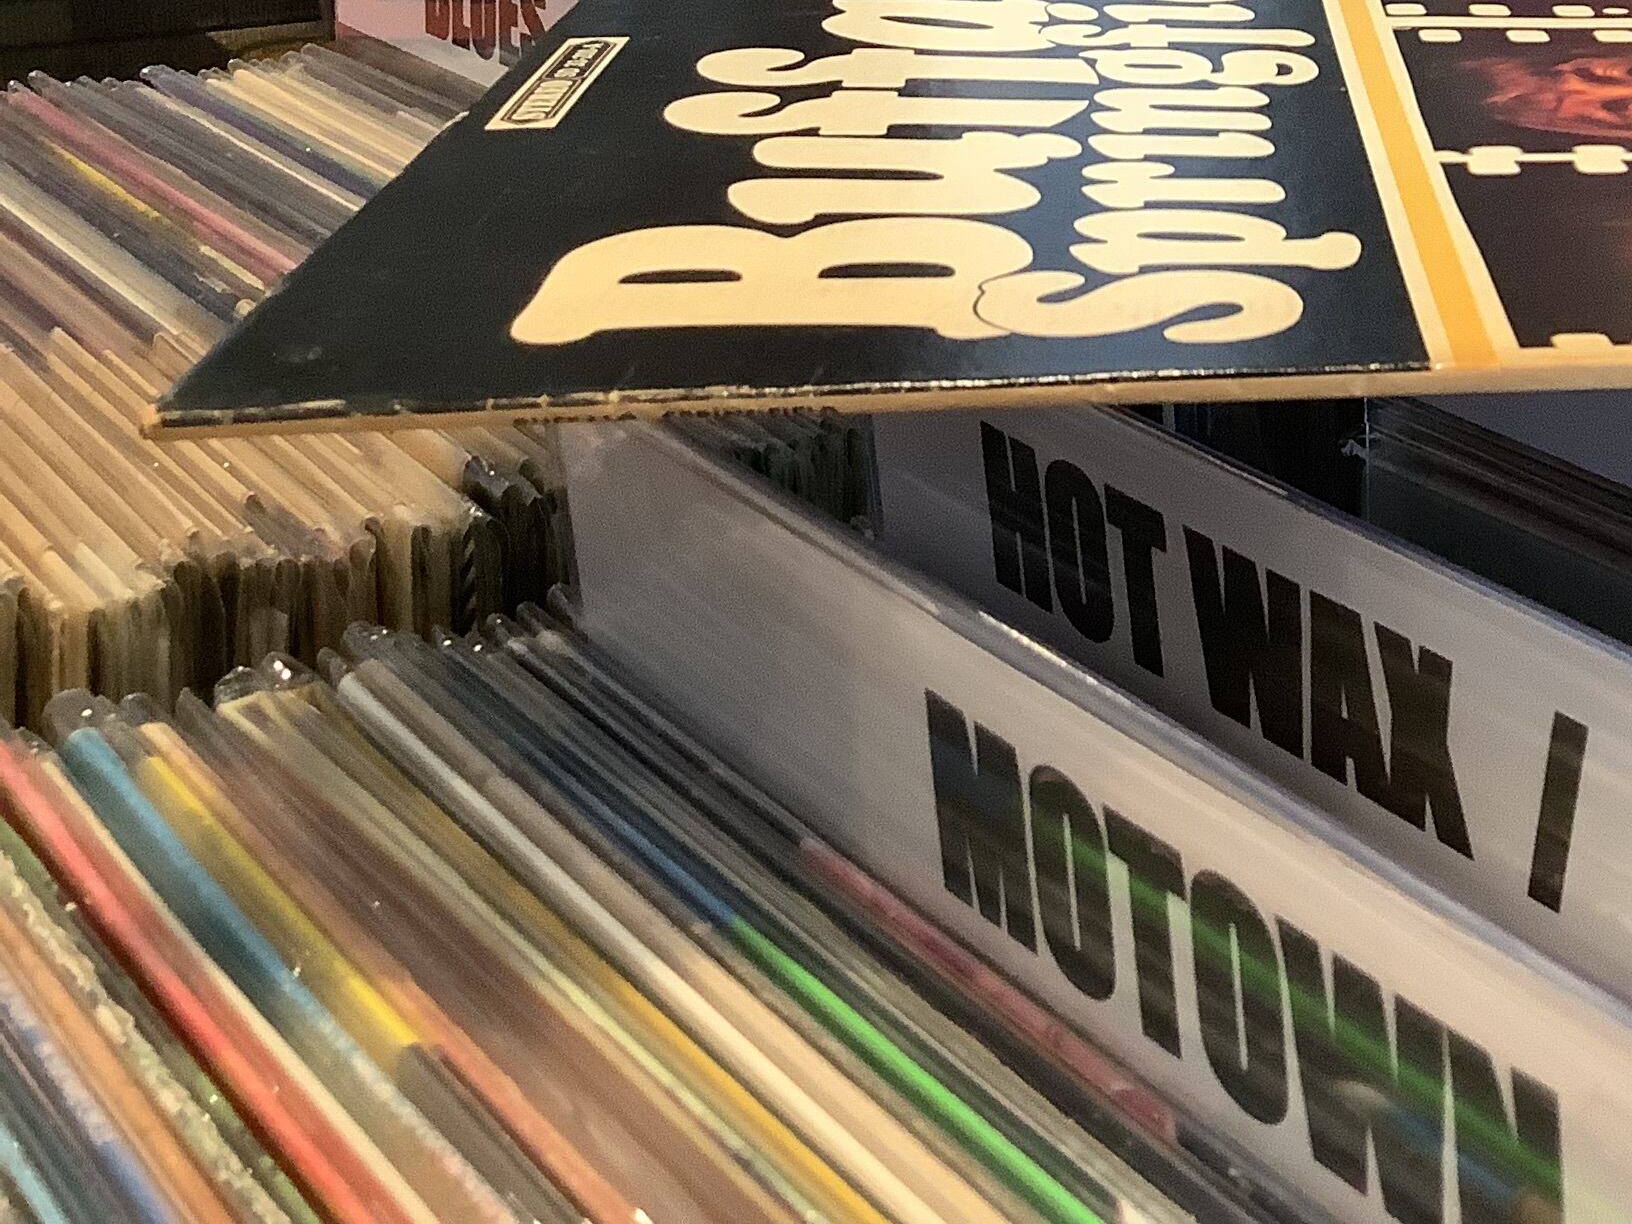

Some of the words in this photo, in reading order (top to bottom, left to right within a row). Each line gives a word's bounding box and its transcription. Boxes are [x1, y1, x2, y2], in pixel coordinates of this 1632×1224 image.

[981, 421, 1167, 678] HOT
[1183, 525, 1475, 862] WAX
[925, 688, 1565, 1224] MOTOWN
